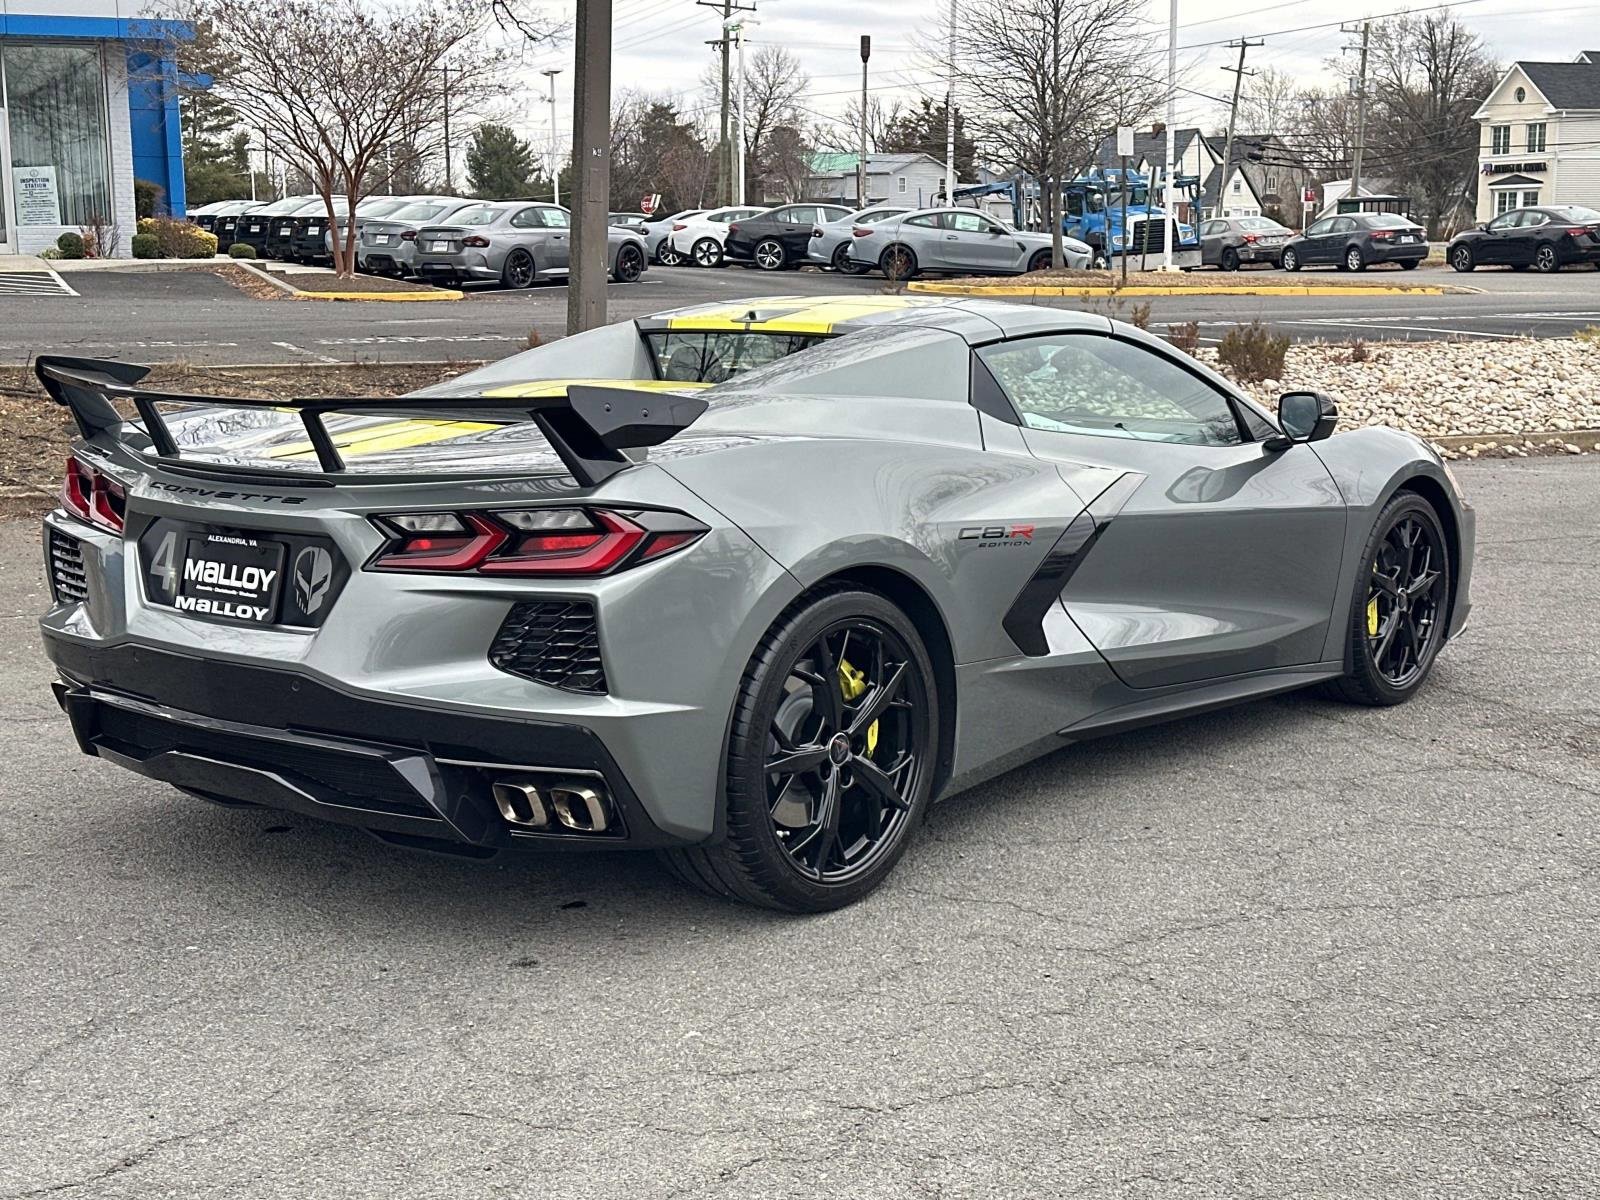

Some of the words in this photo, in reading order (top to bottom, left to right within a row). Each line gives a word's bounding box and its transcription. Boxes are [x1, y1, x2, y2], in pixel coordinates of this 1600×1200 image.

[150, 481, 308, 504] CORVETTE
[207, 534, 248, 546] ALEXANDRIA,
[249, 539, 258, 547] VA
[958, 525, 1034, 540] C8.R
[151, 531, 177, 591] 4
